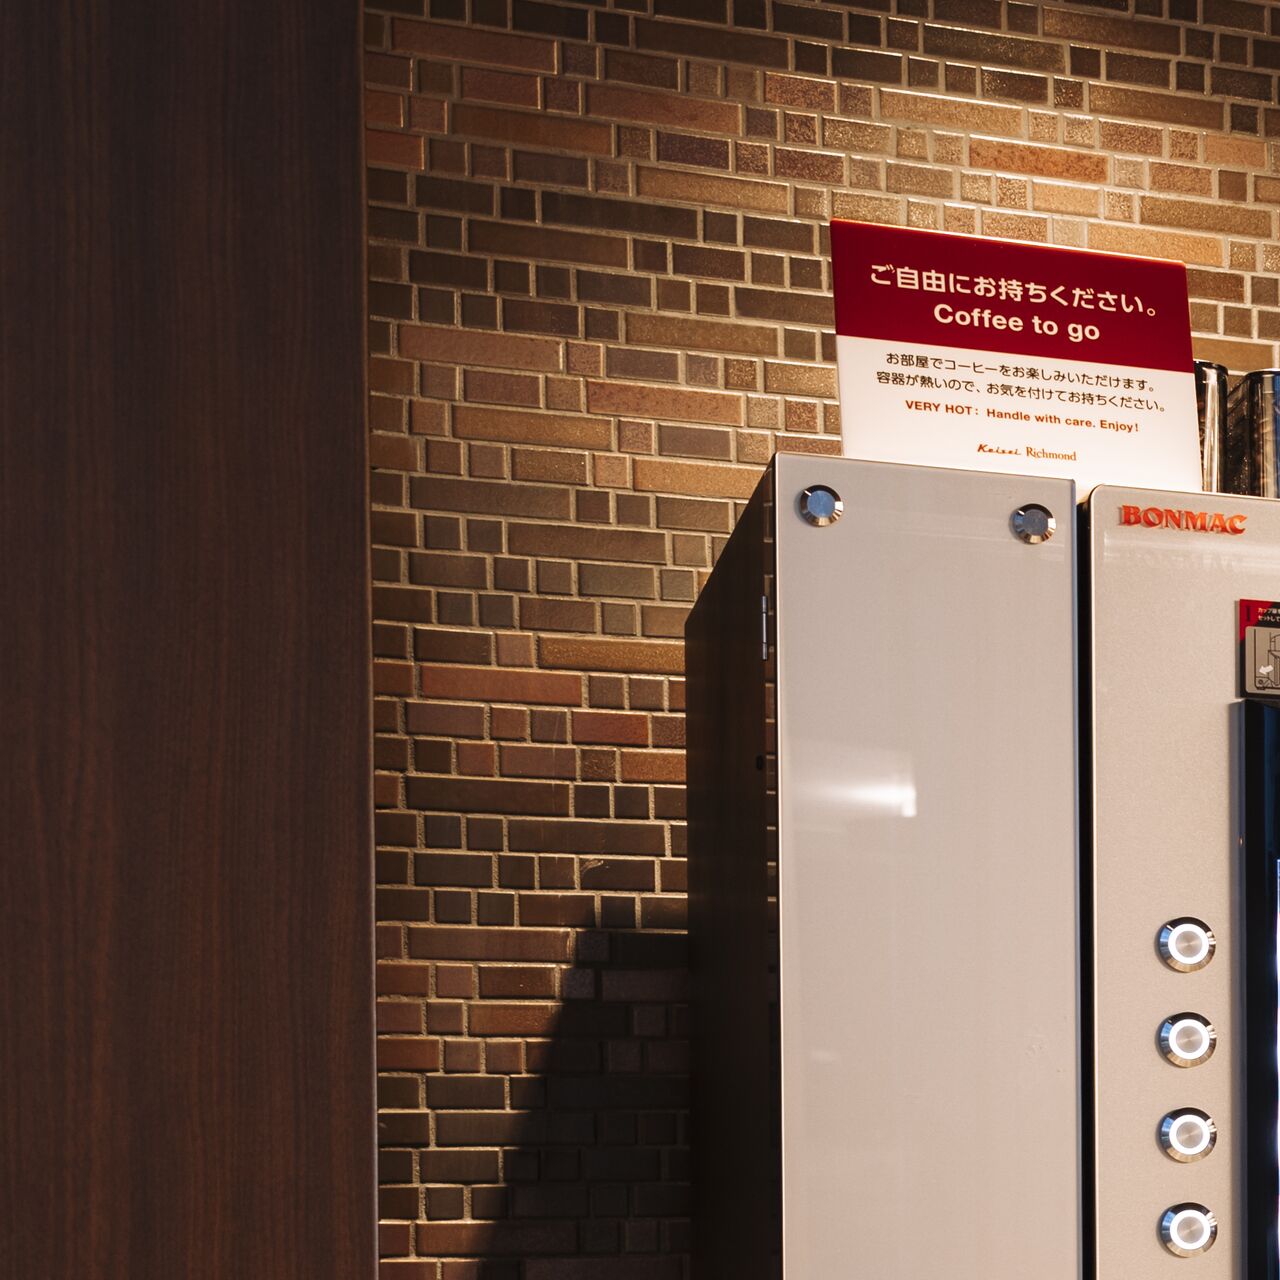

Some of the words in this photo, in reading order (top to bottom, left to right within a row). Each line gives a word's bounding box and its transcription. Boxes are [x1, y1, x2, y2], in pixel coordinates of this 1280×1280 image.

[870, 263, 1156, 317] ご自由にお持ちください。
[933, 303, 1023, 332] Coffee
[1032, 314, 1058, 336] to
[1067, 319, 1100, 342] go
[876, 371, 1165, 412] 容器が熱いので、お気を付けてお持ちください。
[886, 353, 1154, 392] お部屋でコーヒーをお楽しみいただけます。
[905, 400, 941, 412] VERY
[987, 408, 1031, 422] Handle
[1035, 414, 1061, 425] with
[1065, 418, 1096, 428] care.
[1026, 446, 1077, 461] Richmond
[1121, 505, 1248, 535] BONMAC
